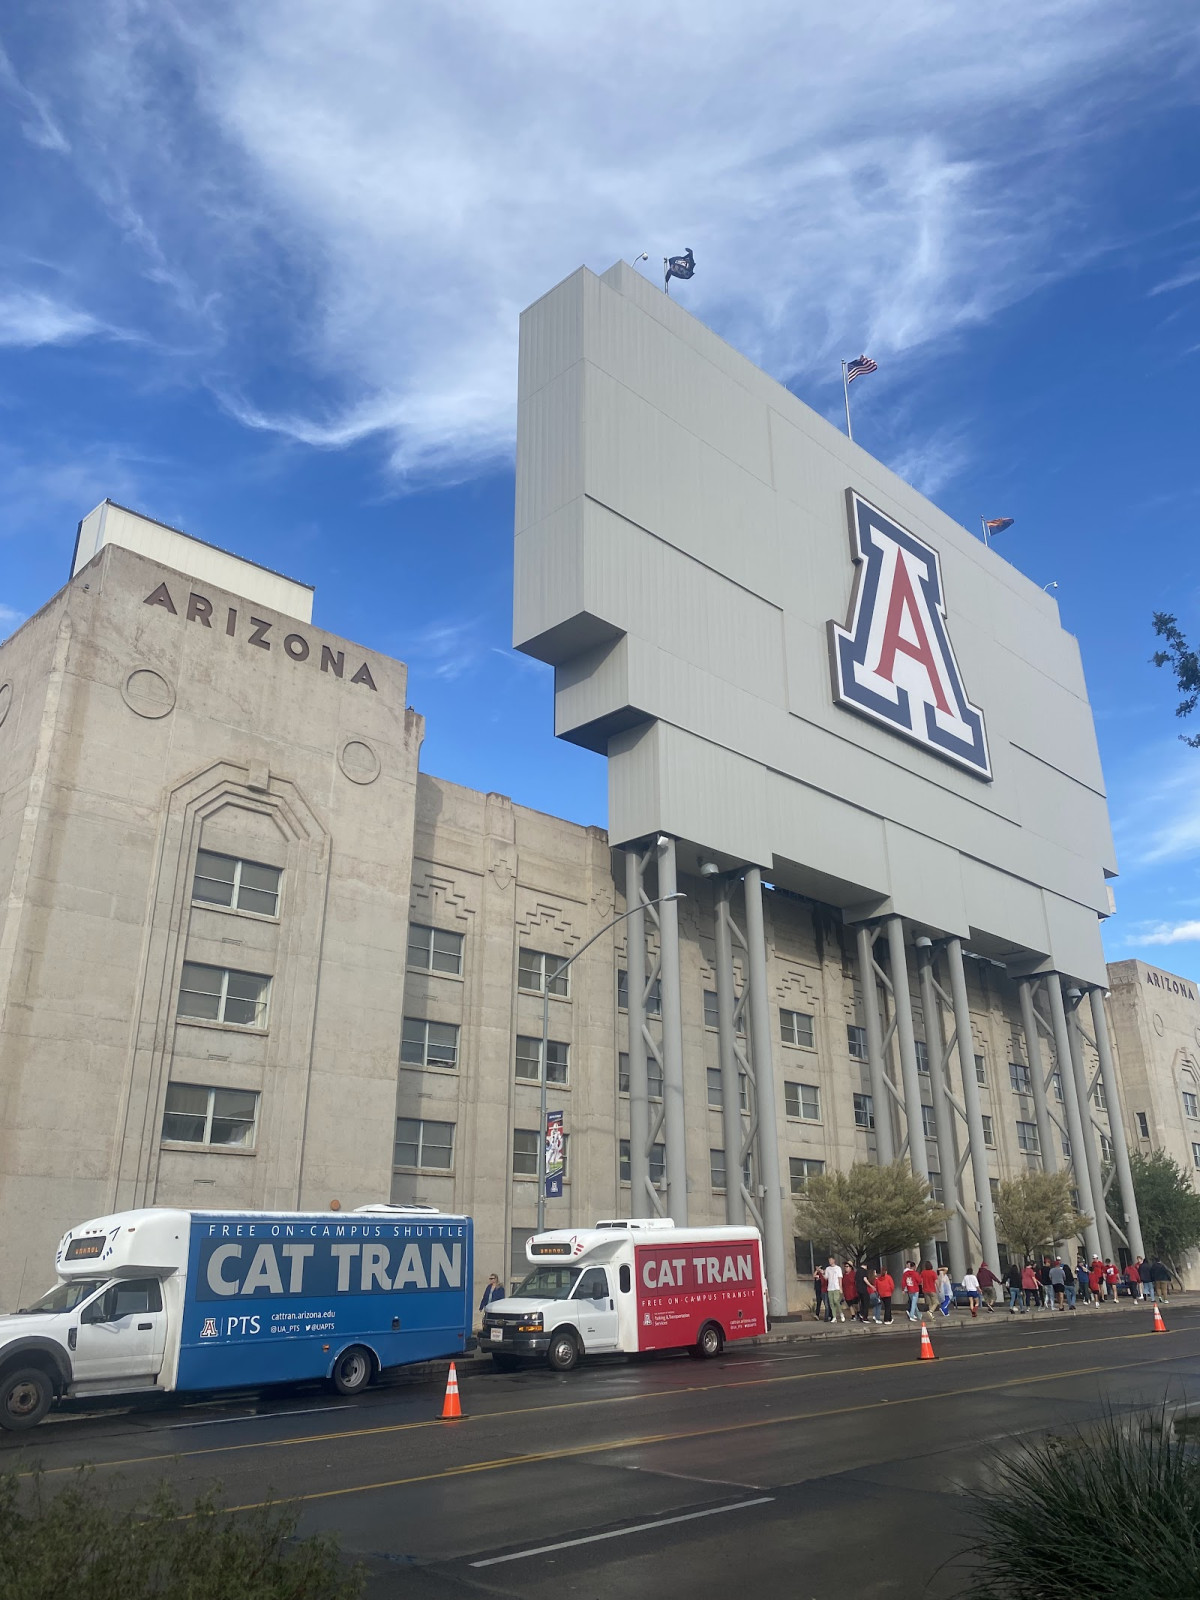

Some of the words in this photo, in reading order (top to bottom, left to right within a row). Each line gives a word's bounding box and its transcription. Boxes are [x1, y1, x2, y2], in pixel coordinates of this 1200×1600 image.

[143, 582, 378, 692] ARIZONA
[834, 490, 993, 780] A
[1147, 971, 1195, 1001] ARIZONA
[208, 1224, 256, 1237] FREE
[271, 1224, 381, 1237] ON-CAMPUS
[393, 1225, 463, 1237] SHUTTLE
[206, 1243, 315, 1296] CAT
[330, 1243, 462, 1292] TRAN
[642, 1259, 686, 1289] CAT
[692, 1254, 753, 1285] TRAN
[641, 1298, 662, 1307] FREE
[667, 1293, 717, 1305] ON-CAMPUS
[722, 1290, 755, 1300] TRANSIT
[199, 1317, 219, 1338] A
[226, 1315, 261, 1336] PTS
[271, 1309, 336, 1321] cattran.arizona.edu
